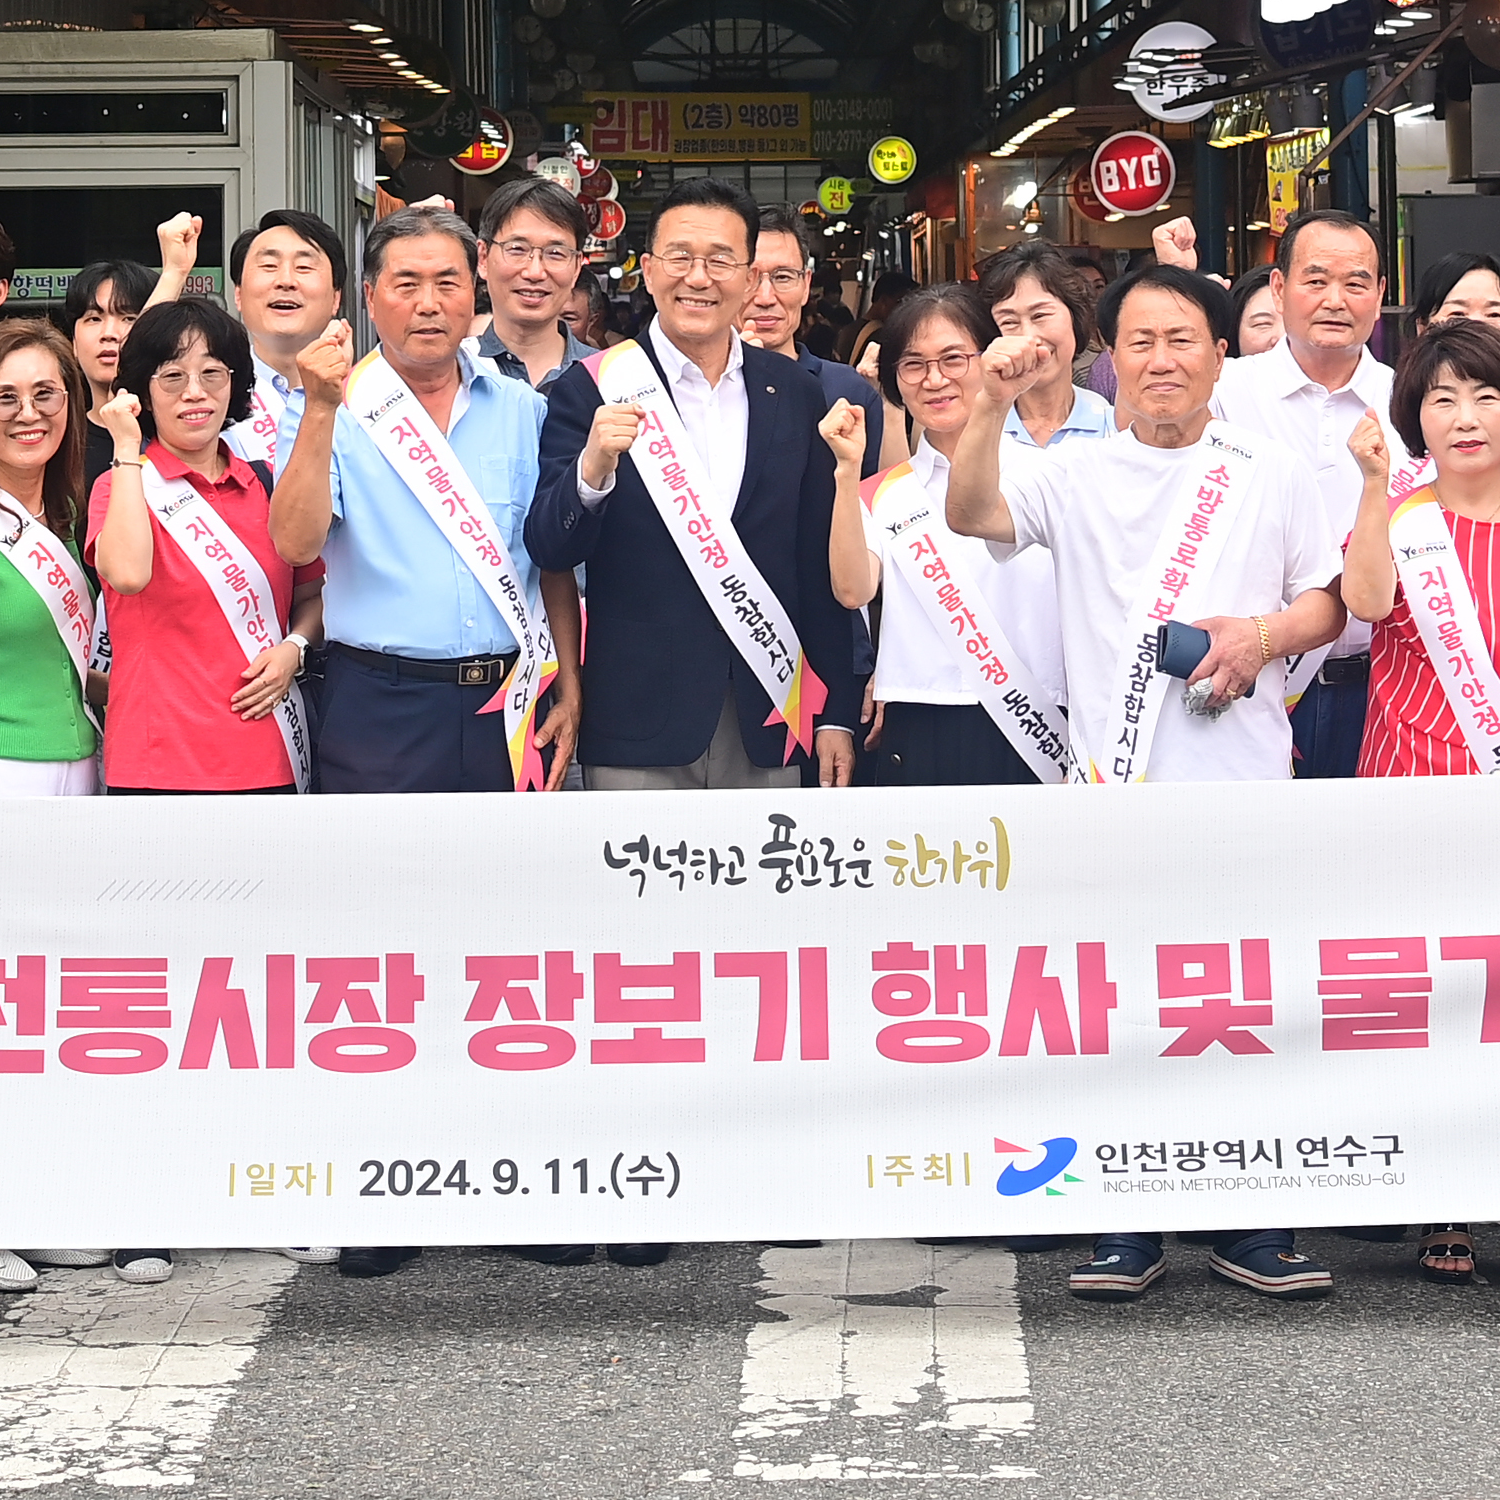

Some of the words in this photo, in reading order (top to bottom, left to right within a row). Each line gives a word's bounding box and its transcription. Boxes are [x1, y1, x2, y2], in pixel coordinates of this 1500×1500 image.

[591, 98, 671, 154] 임대
[682, 102, 733, 130] (2층)
[738, 102, 800, 129] 약80평
[390, 415, 502, 567] 지역물가안정
[496, 574, 537, 715] 동참합시다
[637, 408, 730, 570] 지역물가안정
[719, 573, 796, 686] 동참합시다
[908, 533, 1010, 687] 지역물가안정
[1147, 463, 1231, 624] 소방통로확보
[1112, 632, 1159, 784] 동참합시다
[604, 833, 746, 898] 넉넉하고
[759, 812, 876, 896] 풍요로운
[882, 814, 1011, 893] 한가위
[463, 945, 831, 1072] 장보기
[871, 940, 1118, 1065] 행사
[1156, 937, 1274, 1058] 및
[1095, 1136, 1284, 1175] 인천광역시
[1295, 1133, 1406, 1171] 연수구
[1103, 1178, 1176, 1194] INCHEON
[1179, 1175, 1303, 1193] METROPOLITAN
[1306, 1171, 1407, 1189] YEONSU-GU
